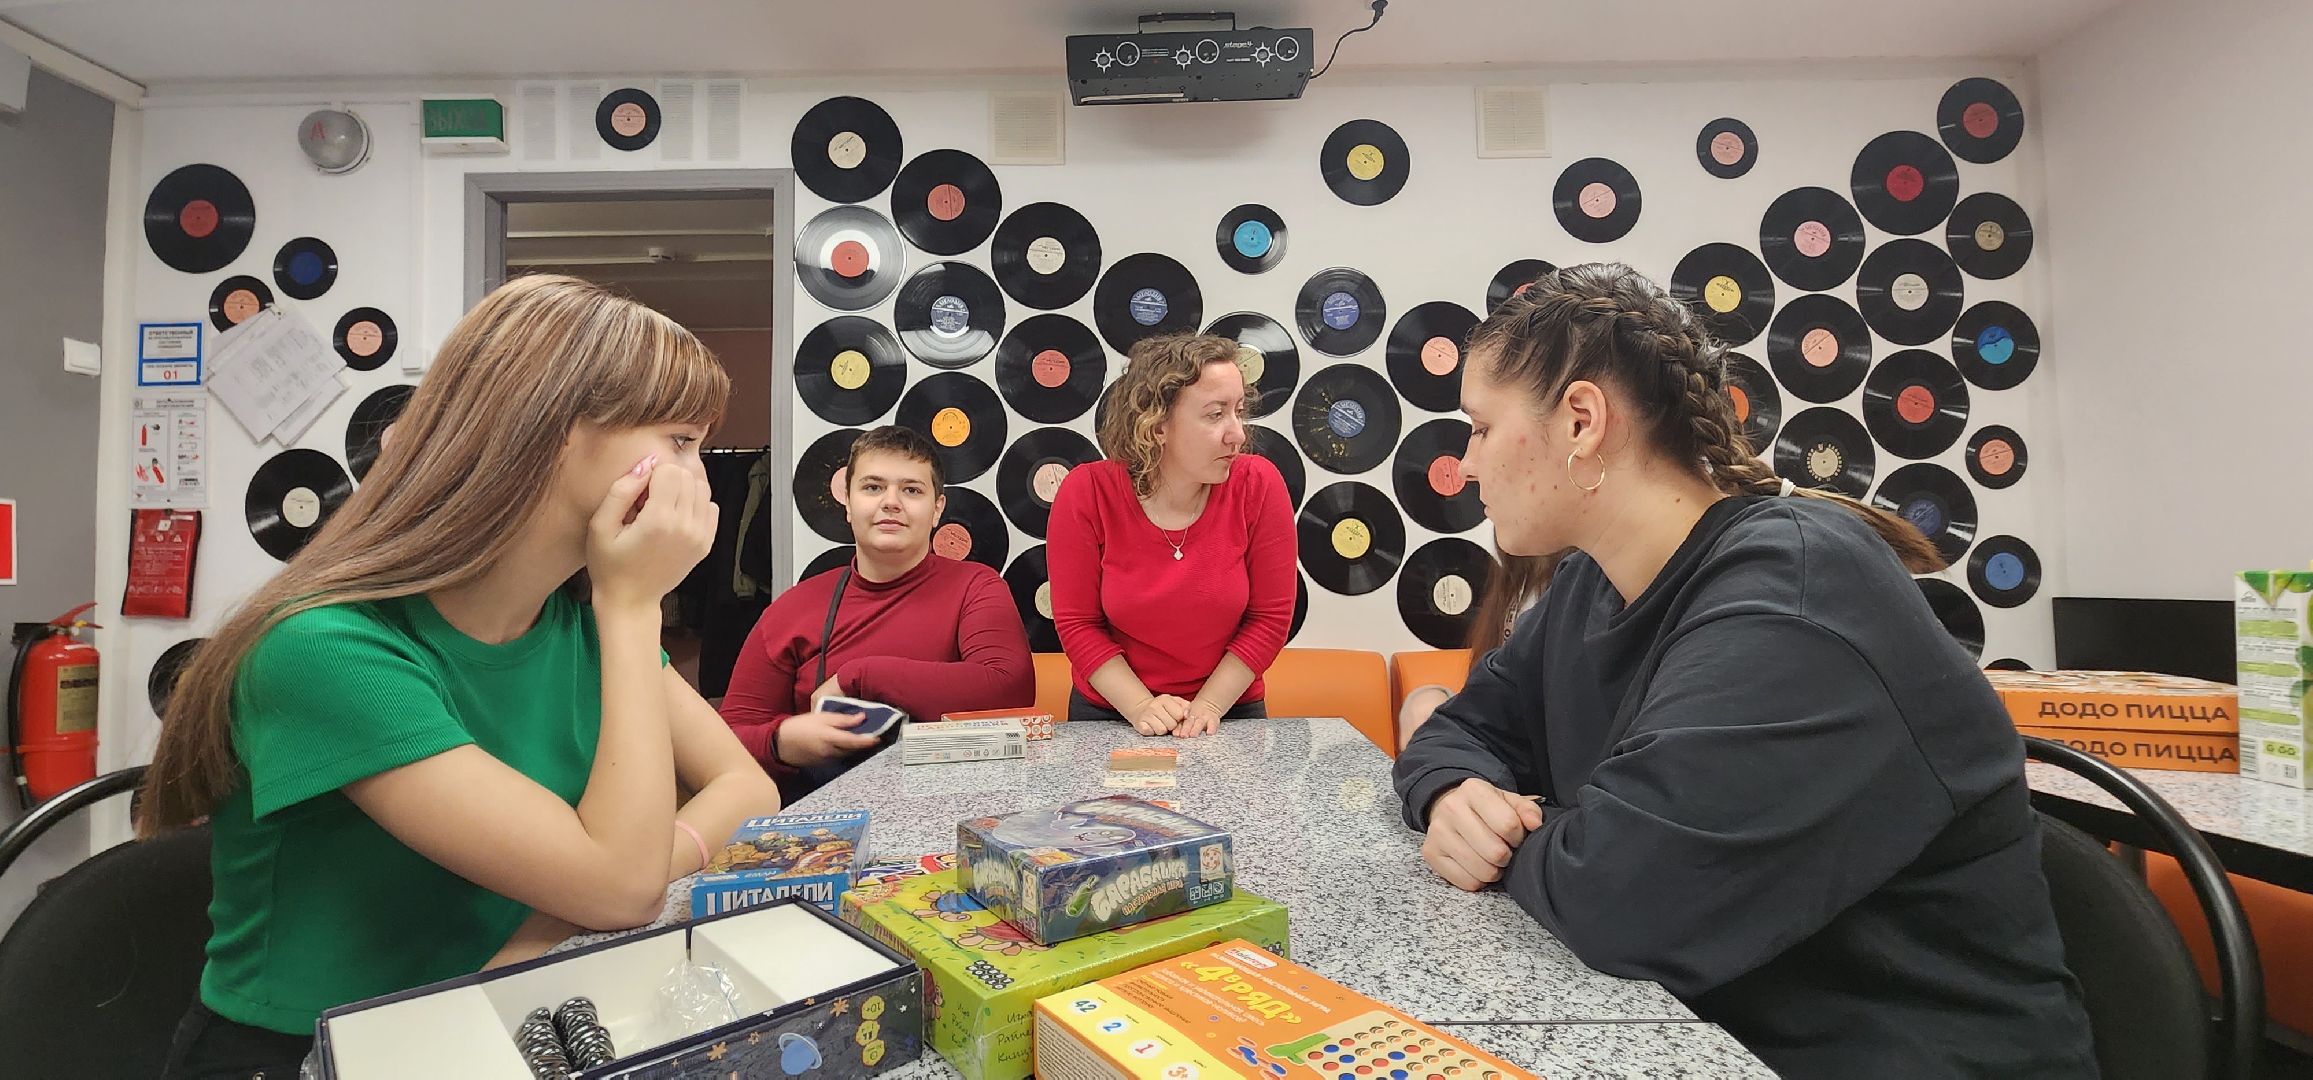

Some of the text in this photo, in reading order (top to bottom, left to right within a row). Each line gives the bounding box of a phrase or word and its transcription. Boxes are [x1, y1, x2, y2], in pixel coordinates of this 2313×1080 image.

[163, 370, 178, 380] 01
[2038, 700, 2231, 724] ДОДО ПИЦЦА
[2135, 743, 2238, 765] ПИЦЦА
[1091, 861, 1186, 922] БАРАБАШКА
[1074, 1000, 1097, 1013] 42
[1102, 1022, 1122, 1032] 2
[1135, 1043, 1154, 1054] 1
[1168, 1066, 1189, 1079] 3+
